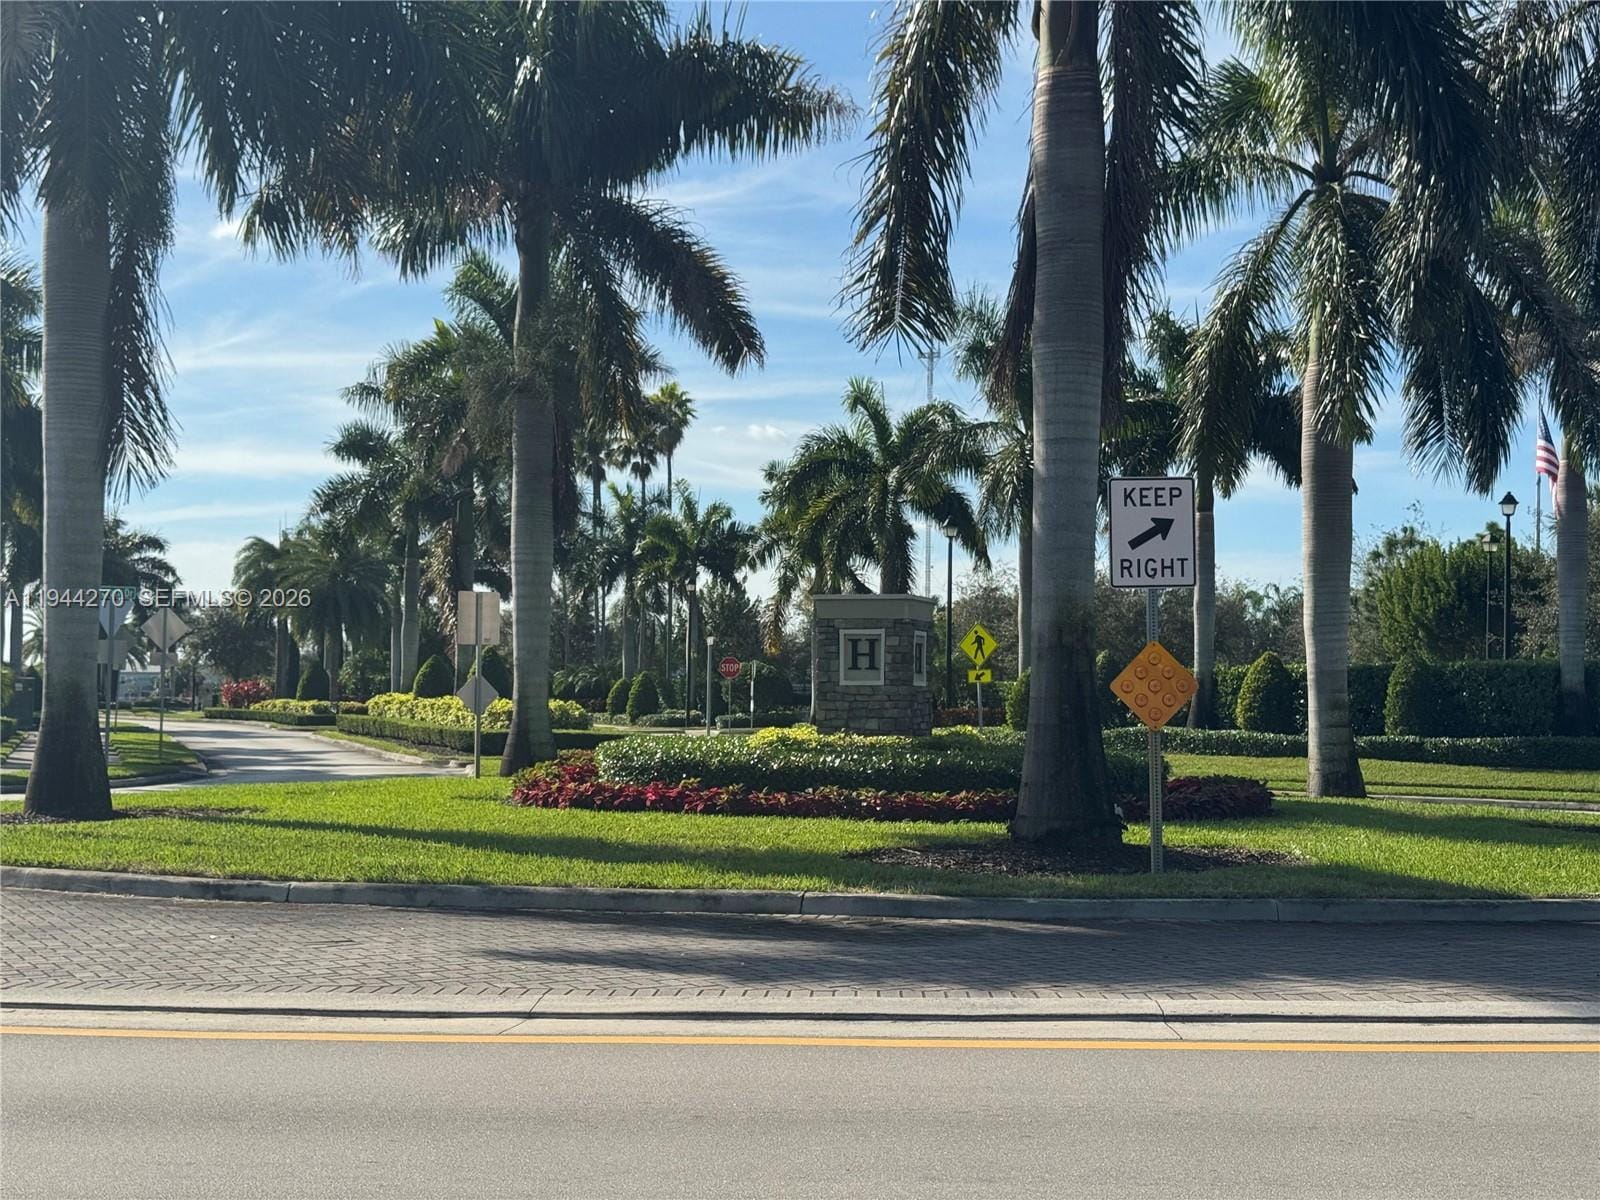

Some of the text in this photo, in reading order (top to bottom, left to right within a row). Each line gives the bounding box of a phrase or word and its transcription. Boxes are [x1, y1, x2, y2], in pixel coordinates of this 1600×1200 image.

[1123, 487, 1182, 507] KEEP
[1120, 558, 1188, 578] RIGHT
[847, 638, 880, 670] H
[721, 663, 739, 672] STOP
